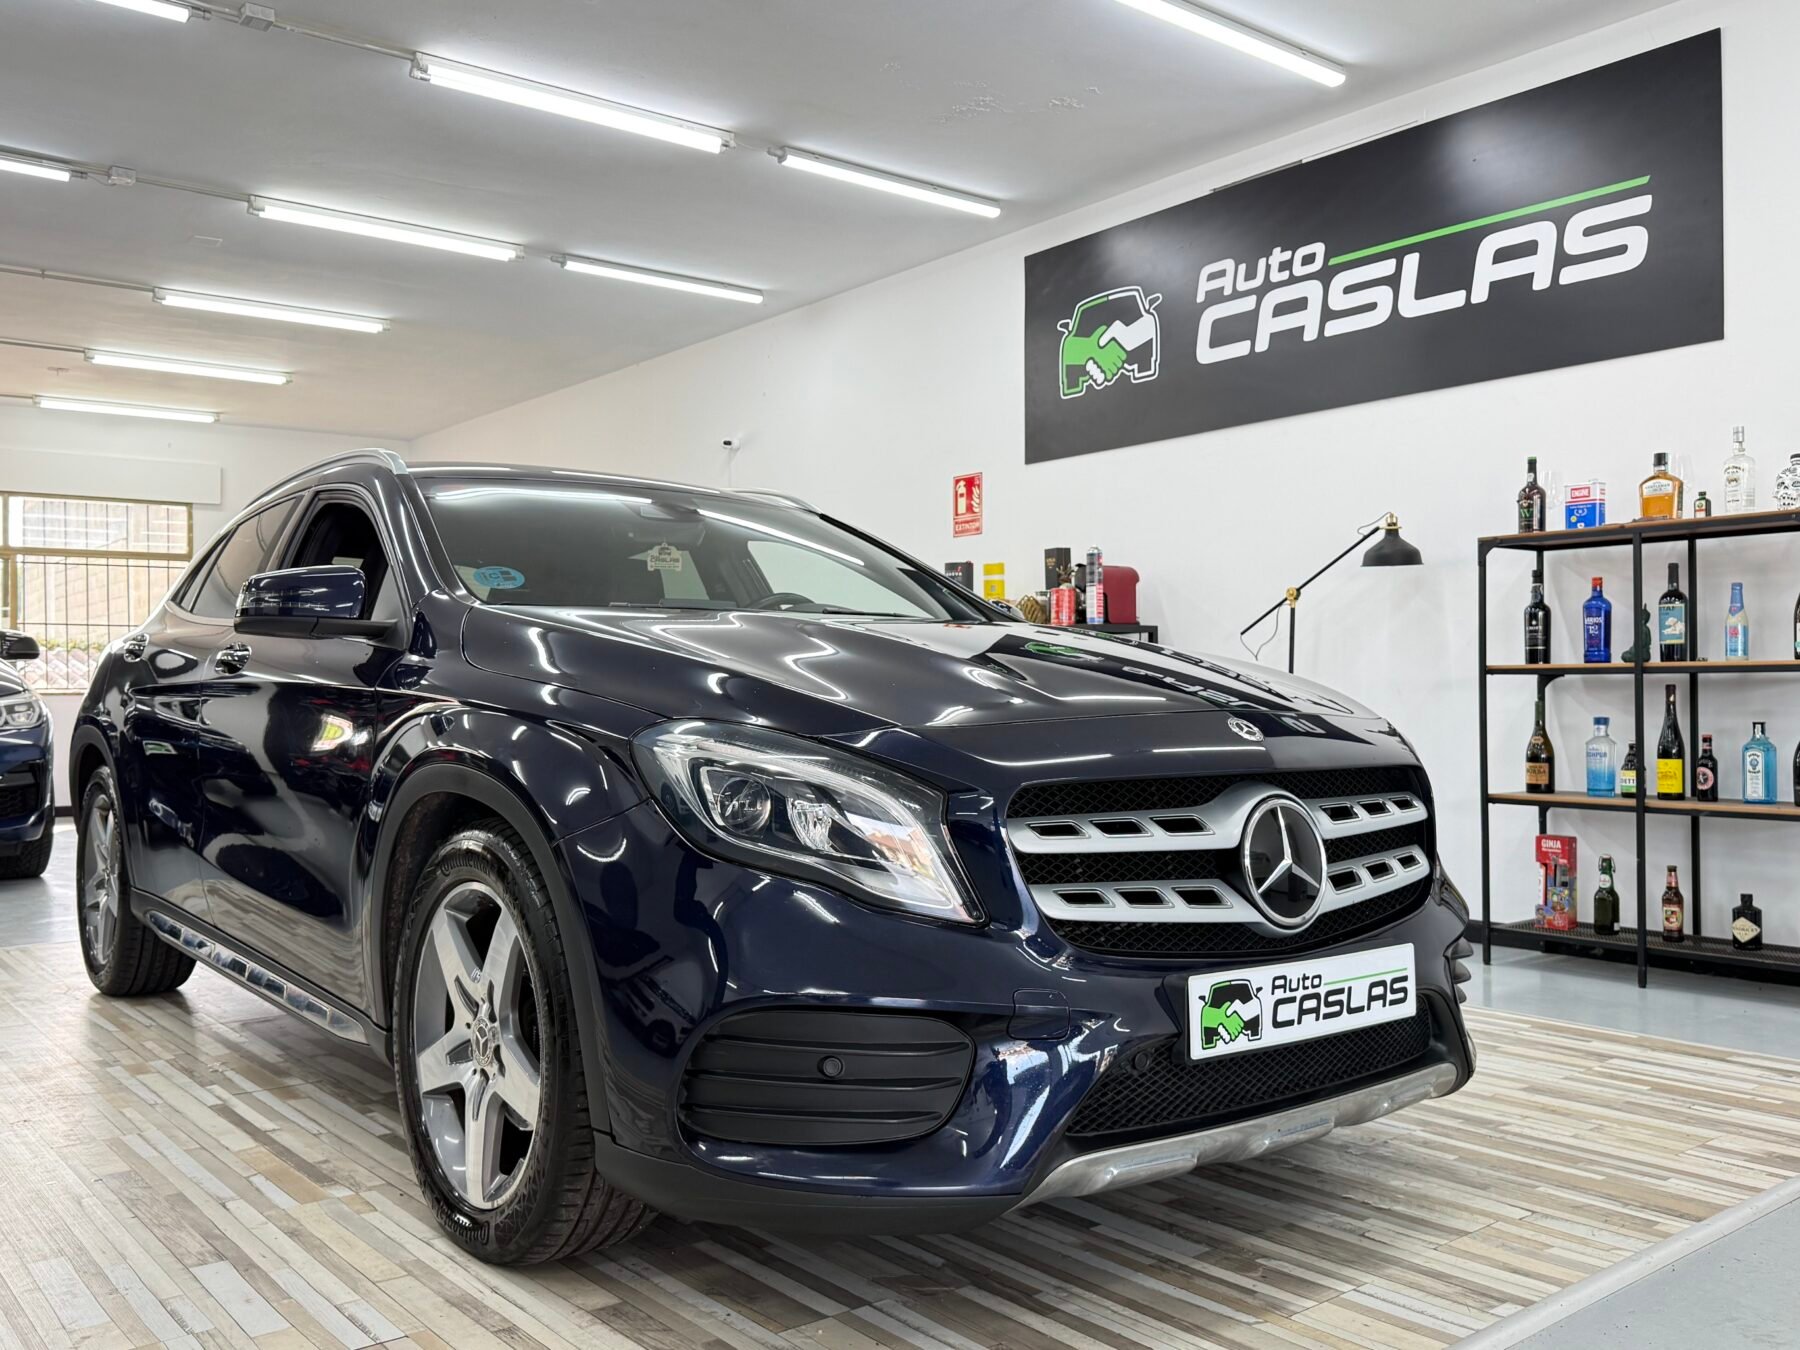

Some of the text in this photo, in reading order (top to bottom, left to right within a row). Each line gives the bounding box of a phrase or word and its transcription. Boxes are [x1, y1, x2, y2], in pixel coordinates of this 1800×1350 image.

[1195, 194, 1652, 365] CASLAS
[1196, 241, 1327, 304] Auto
[955, 519, 980, 531] EXTINTOR
[1541, 838, 1561, 849] GINJA
[1271, 974, 1323, 995] Auto
[1271, 976, 1409, 1029] CASLAS
